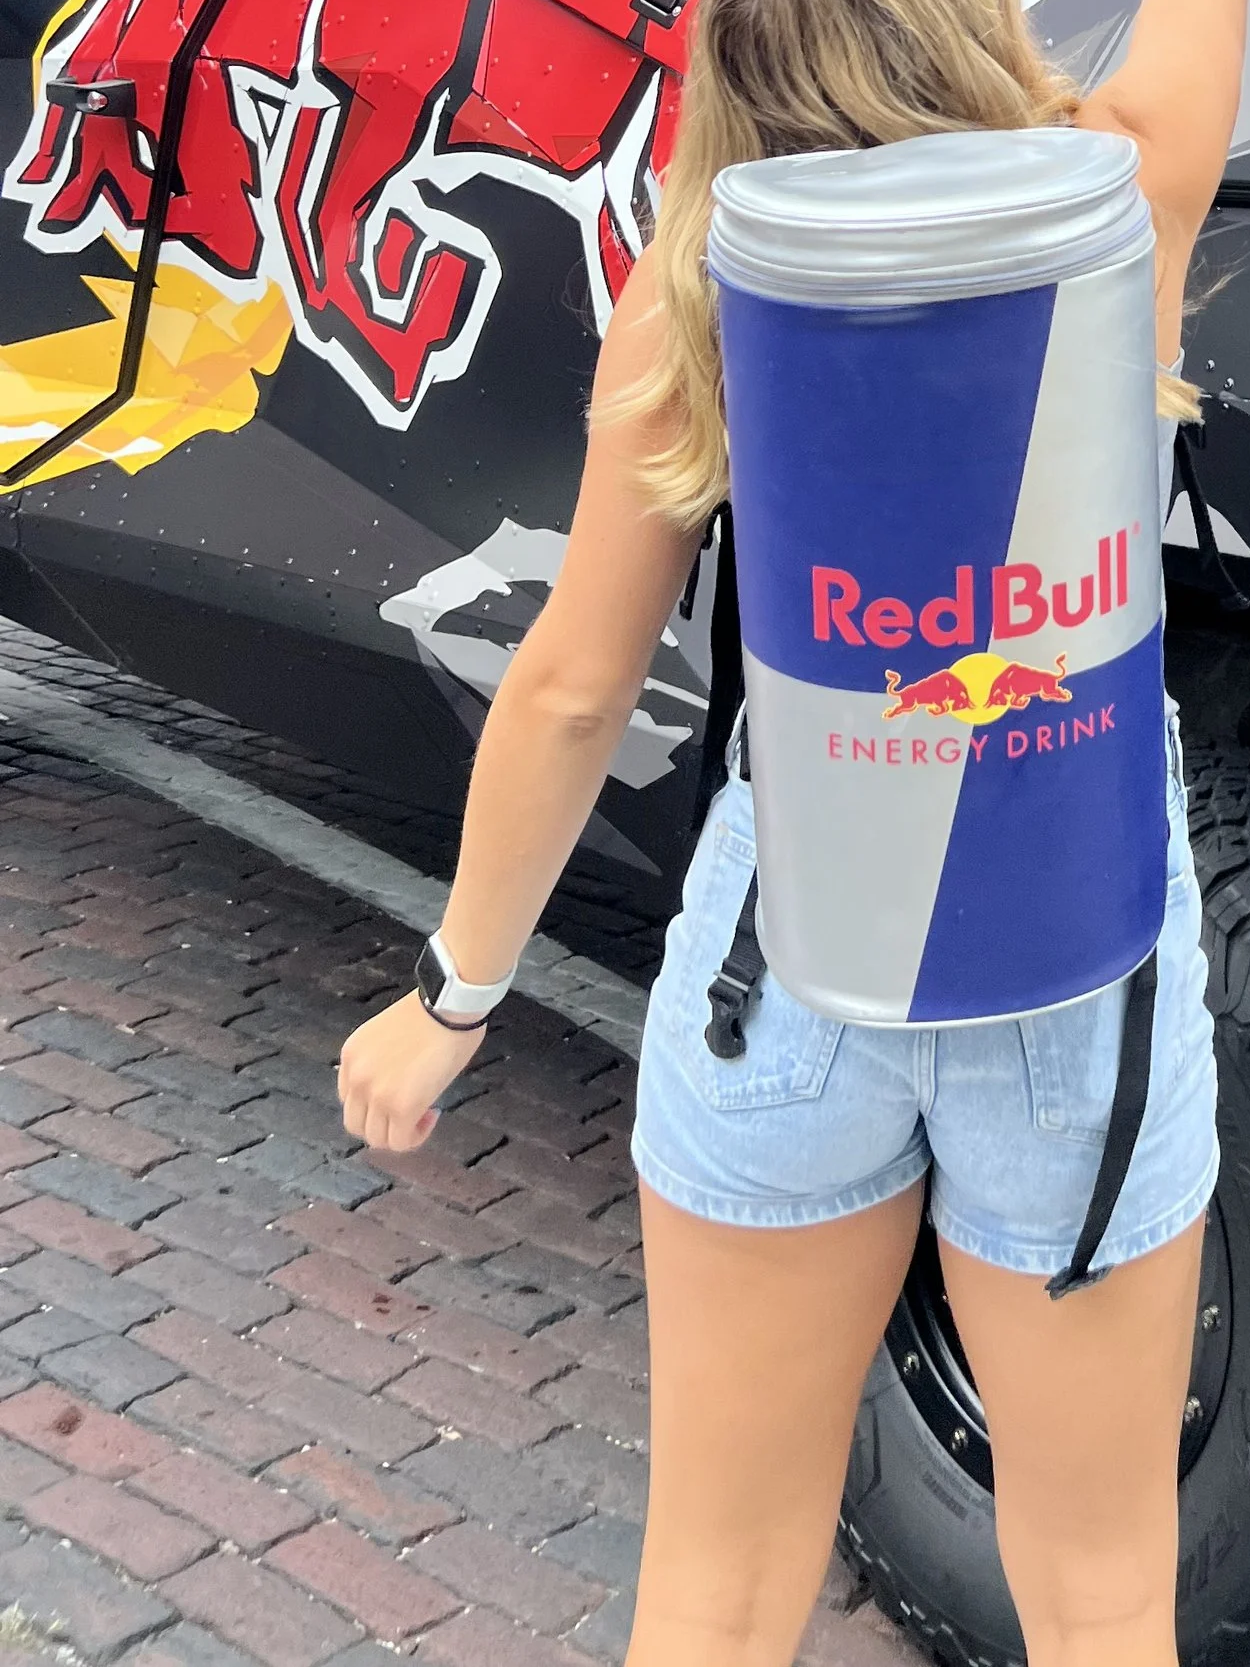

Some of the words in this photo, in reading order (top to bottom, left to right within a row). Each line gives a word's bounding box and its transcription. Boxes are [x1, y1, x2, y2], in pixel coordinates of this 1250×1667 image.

[811, 565, 974, 649] Red
[992, 528, 1128, 640] Bull
[828, 733, 989, 766] ENERGY
[1007, 703, 1116, 759] DRINK
